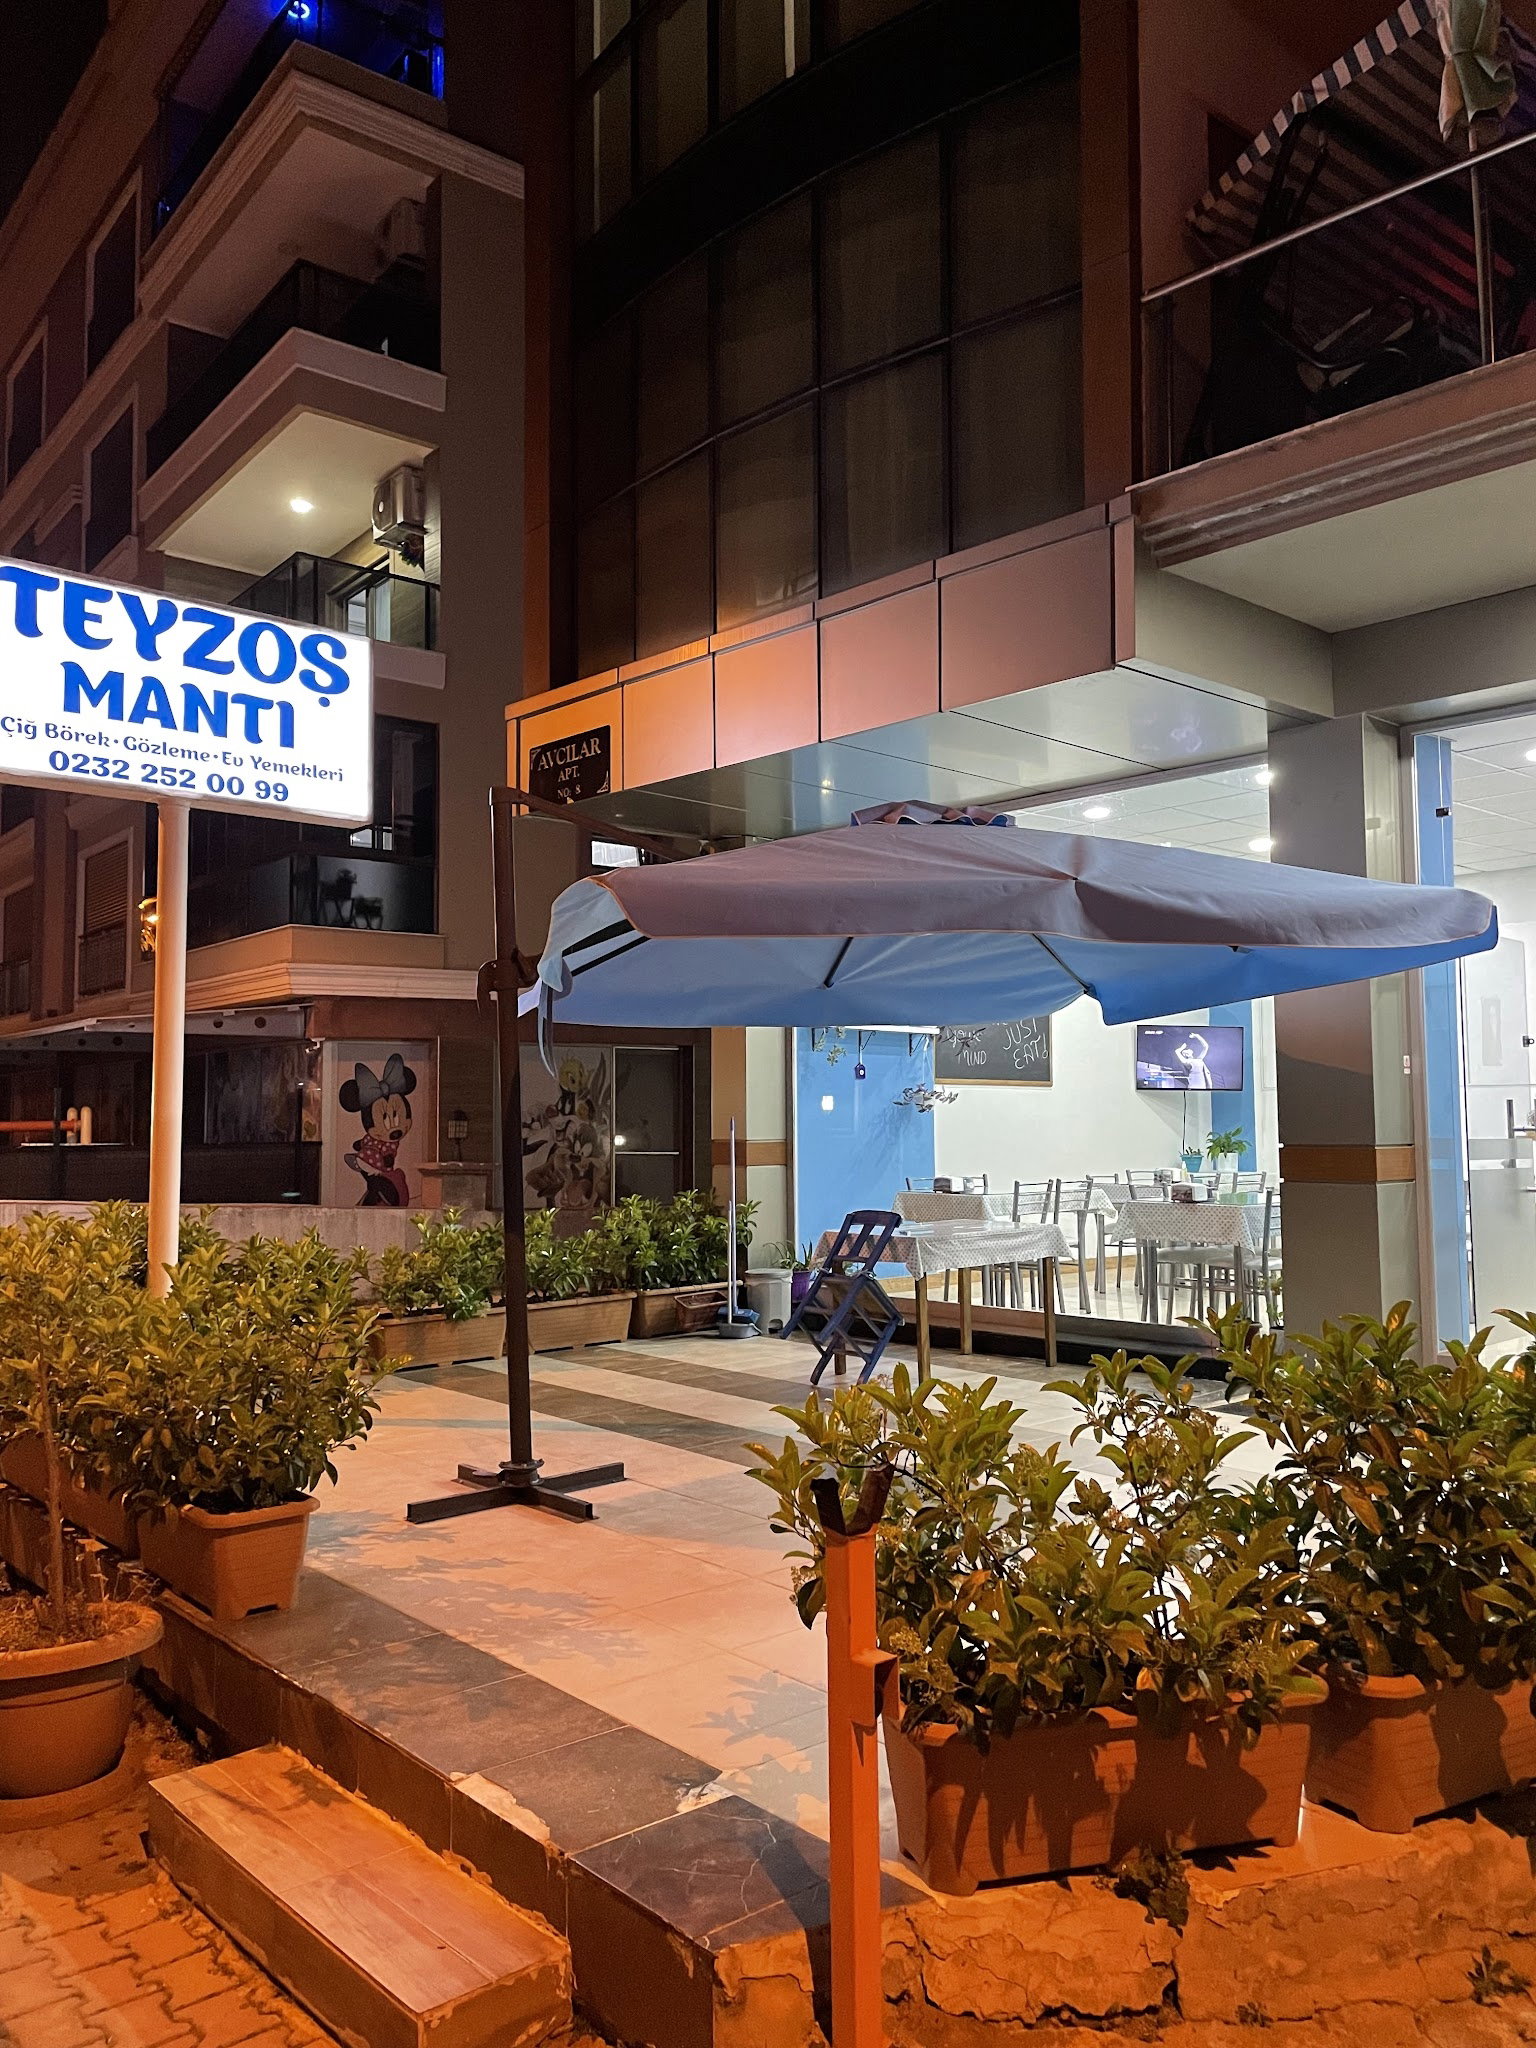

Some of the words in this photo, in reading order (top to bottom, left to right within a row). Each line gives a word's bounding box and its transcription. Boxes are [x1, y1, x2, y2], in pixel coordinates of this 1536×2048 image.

[0, 565, 350, 708] TEYZOŞ
[60, 661, 295, 750] MANTI
[1, 716, 37, 740] Çiğ
[45, 723, 110, 748] Börek
[123, 736, 211, 763] Gözleme
[221, 751, 244, 768] Ev
[250, 755, 344, 783] Yemekleri
[537, 737, 602, 772] AVCILAR
[557, 765, 580, 783] APT.
[49, 750, 130, 780] 0232
[140, 763, 197, 790] 252
[206, 773, 245, 797] 00
[254, 779, 289, 802] 99
[1013, 1032, 1049, 1070] EAT!
